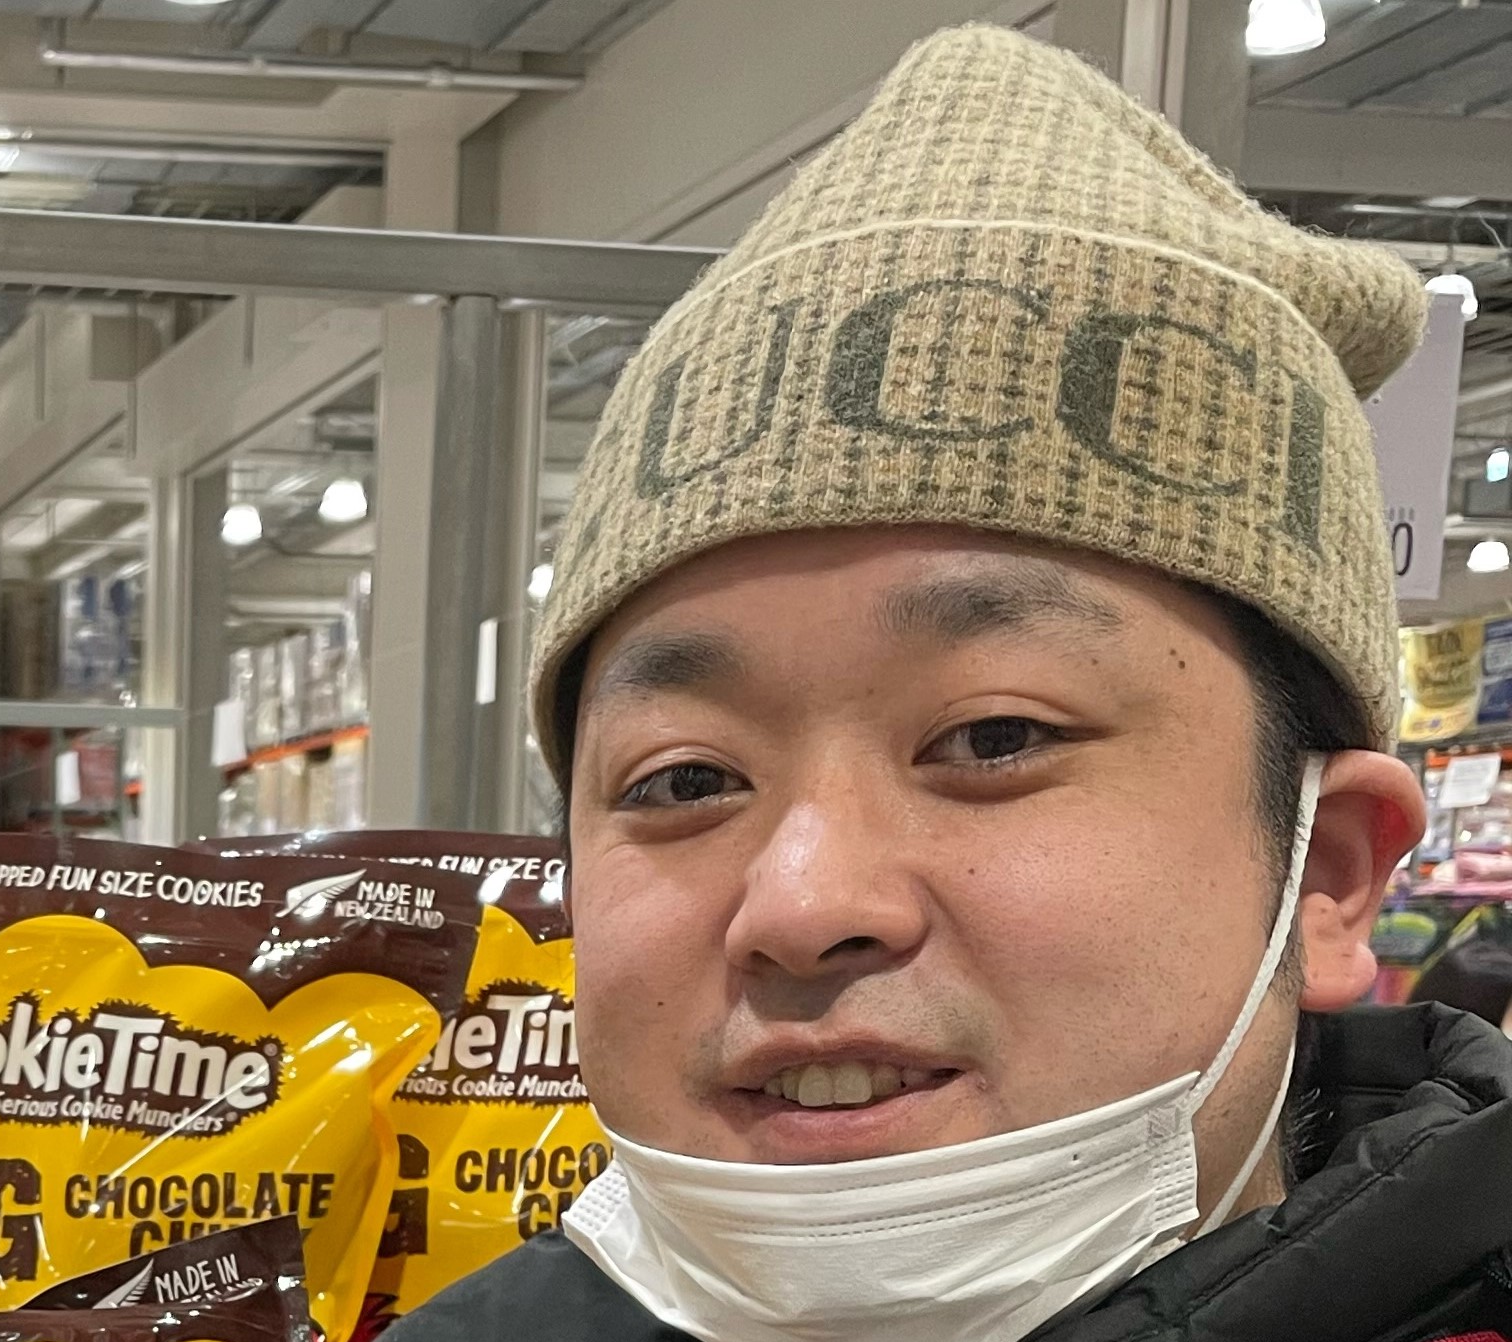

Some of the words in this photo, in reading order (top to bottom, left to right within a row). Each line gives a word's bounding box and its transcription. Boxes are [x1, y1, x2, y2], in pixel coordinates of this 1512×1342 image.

[637, 277, 1326, 552] UCCI
[46, 865, 97, 891] FUN
[97, 870, 155, 898] SIZE
[156, 874, 264, 908] COOKIES
[356, 880, 412, 903] MADE
[414, 887, 436, 909] IN
[451, 1074, 516, 1098] Cookie
[60, 1094, 124, 1122] Cookie
[64, 1171, 335, 1219] CHOCOLATE
[154, 1259, 215, 1304] MADE
[215, 1253, 240, 1284] IN
